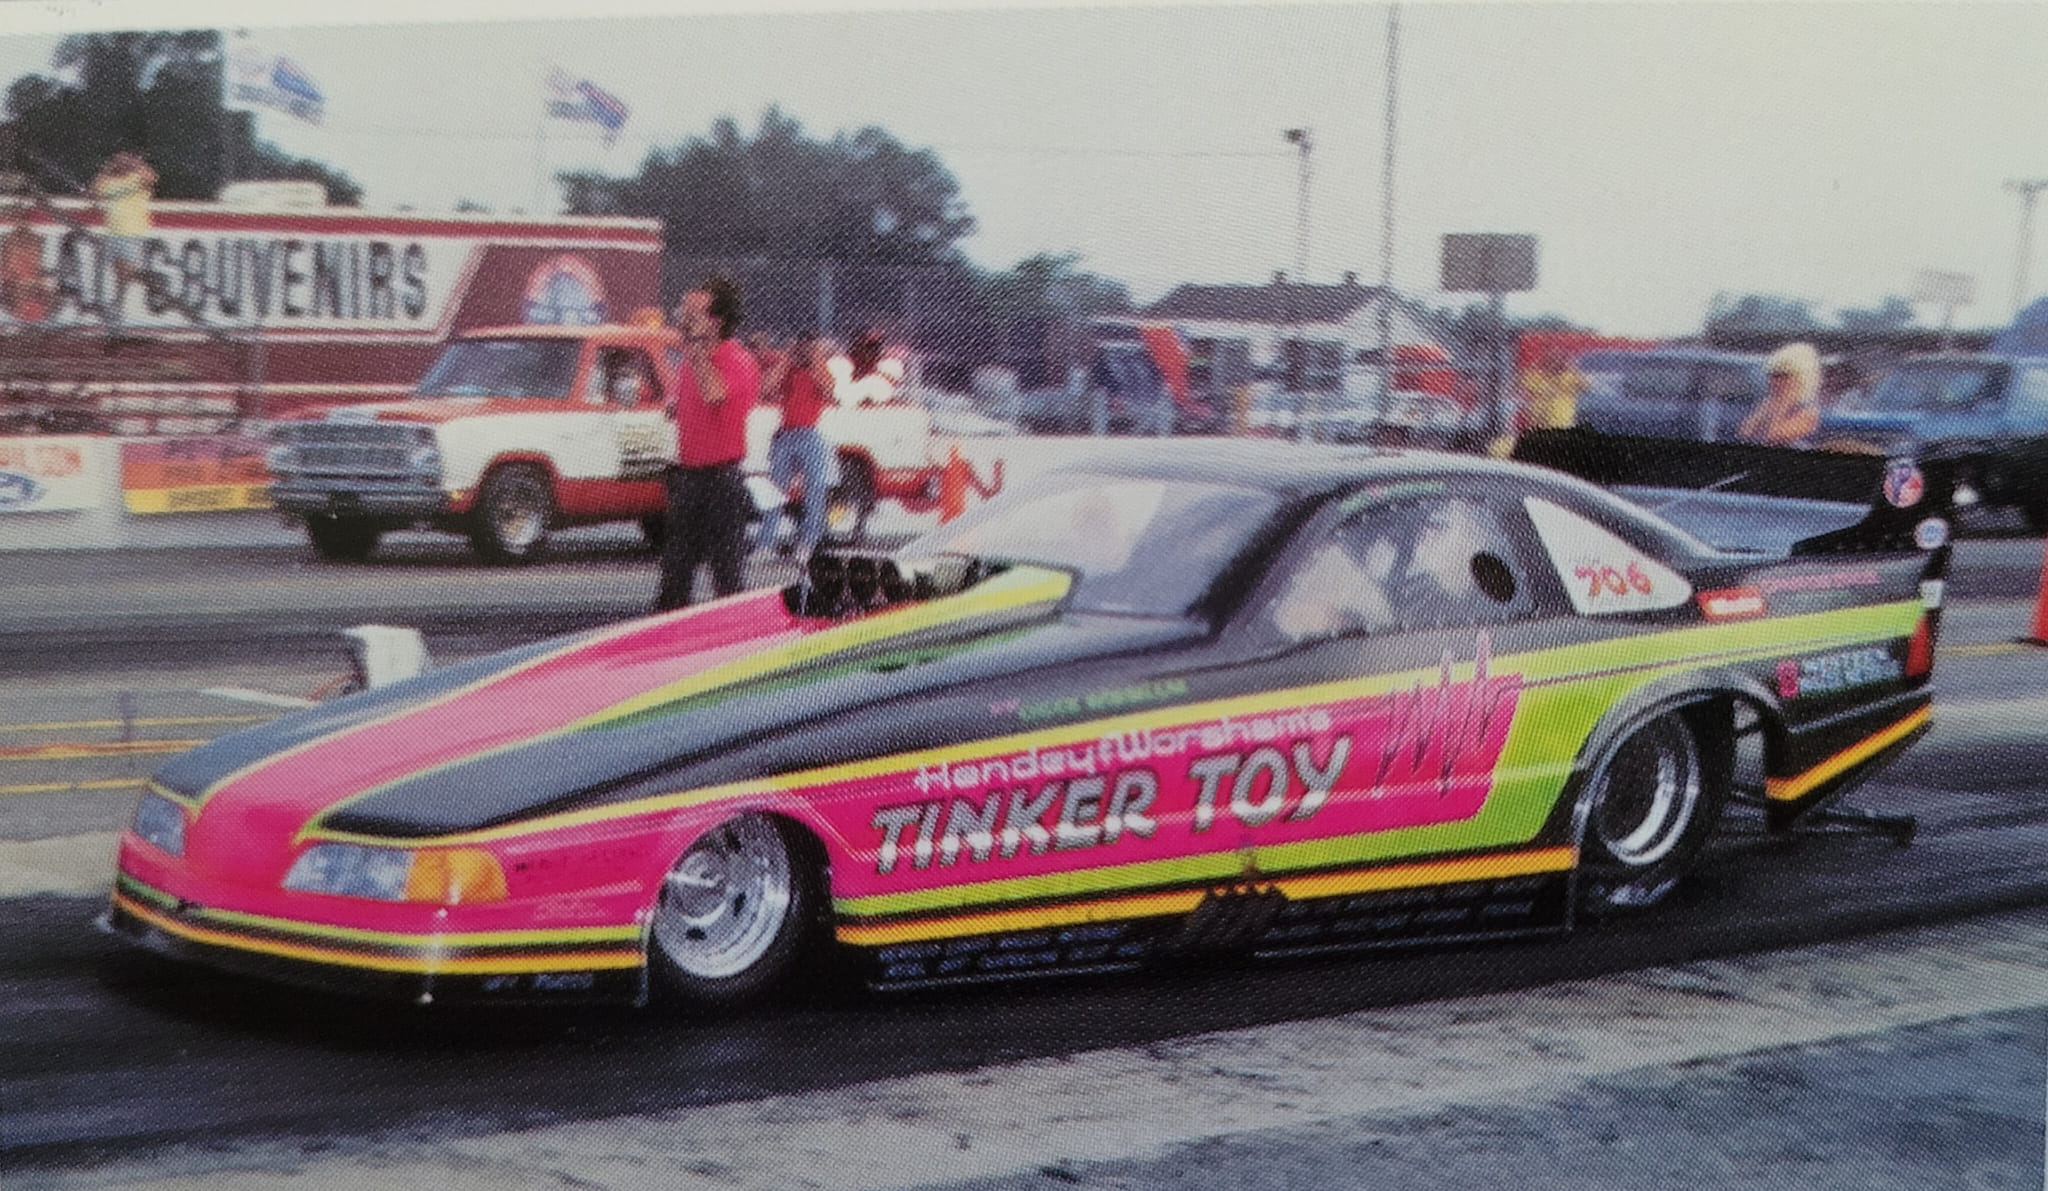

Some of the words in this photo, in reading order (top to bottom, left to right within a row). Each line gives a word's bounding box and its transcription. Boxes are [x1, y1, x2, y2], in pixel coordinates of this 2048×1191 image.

[144, 238, 428, 320] SOUVENIRS
[1574, 561, 1655, 598] 706
[871, 767, 1160, 875] TINKER
[1188, 735, 1353, 833] TOY
